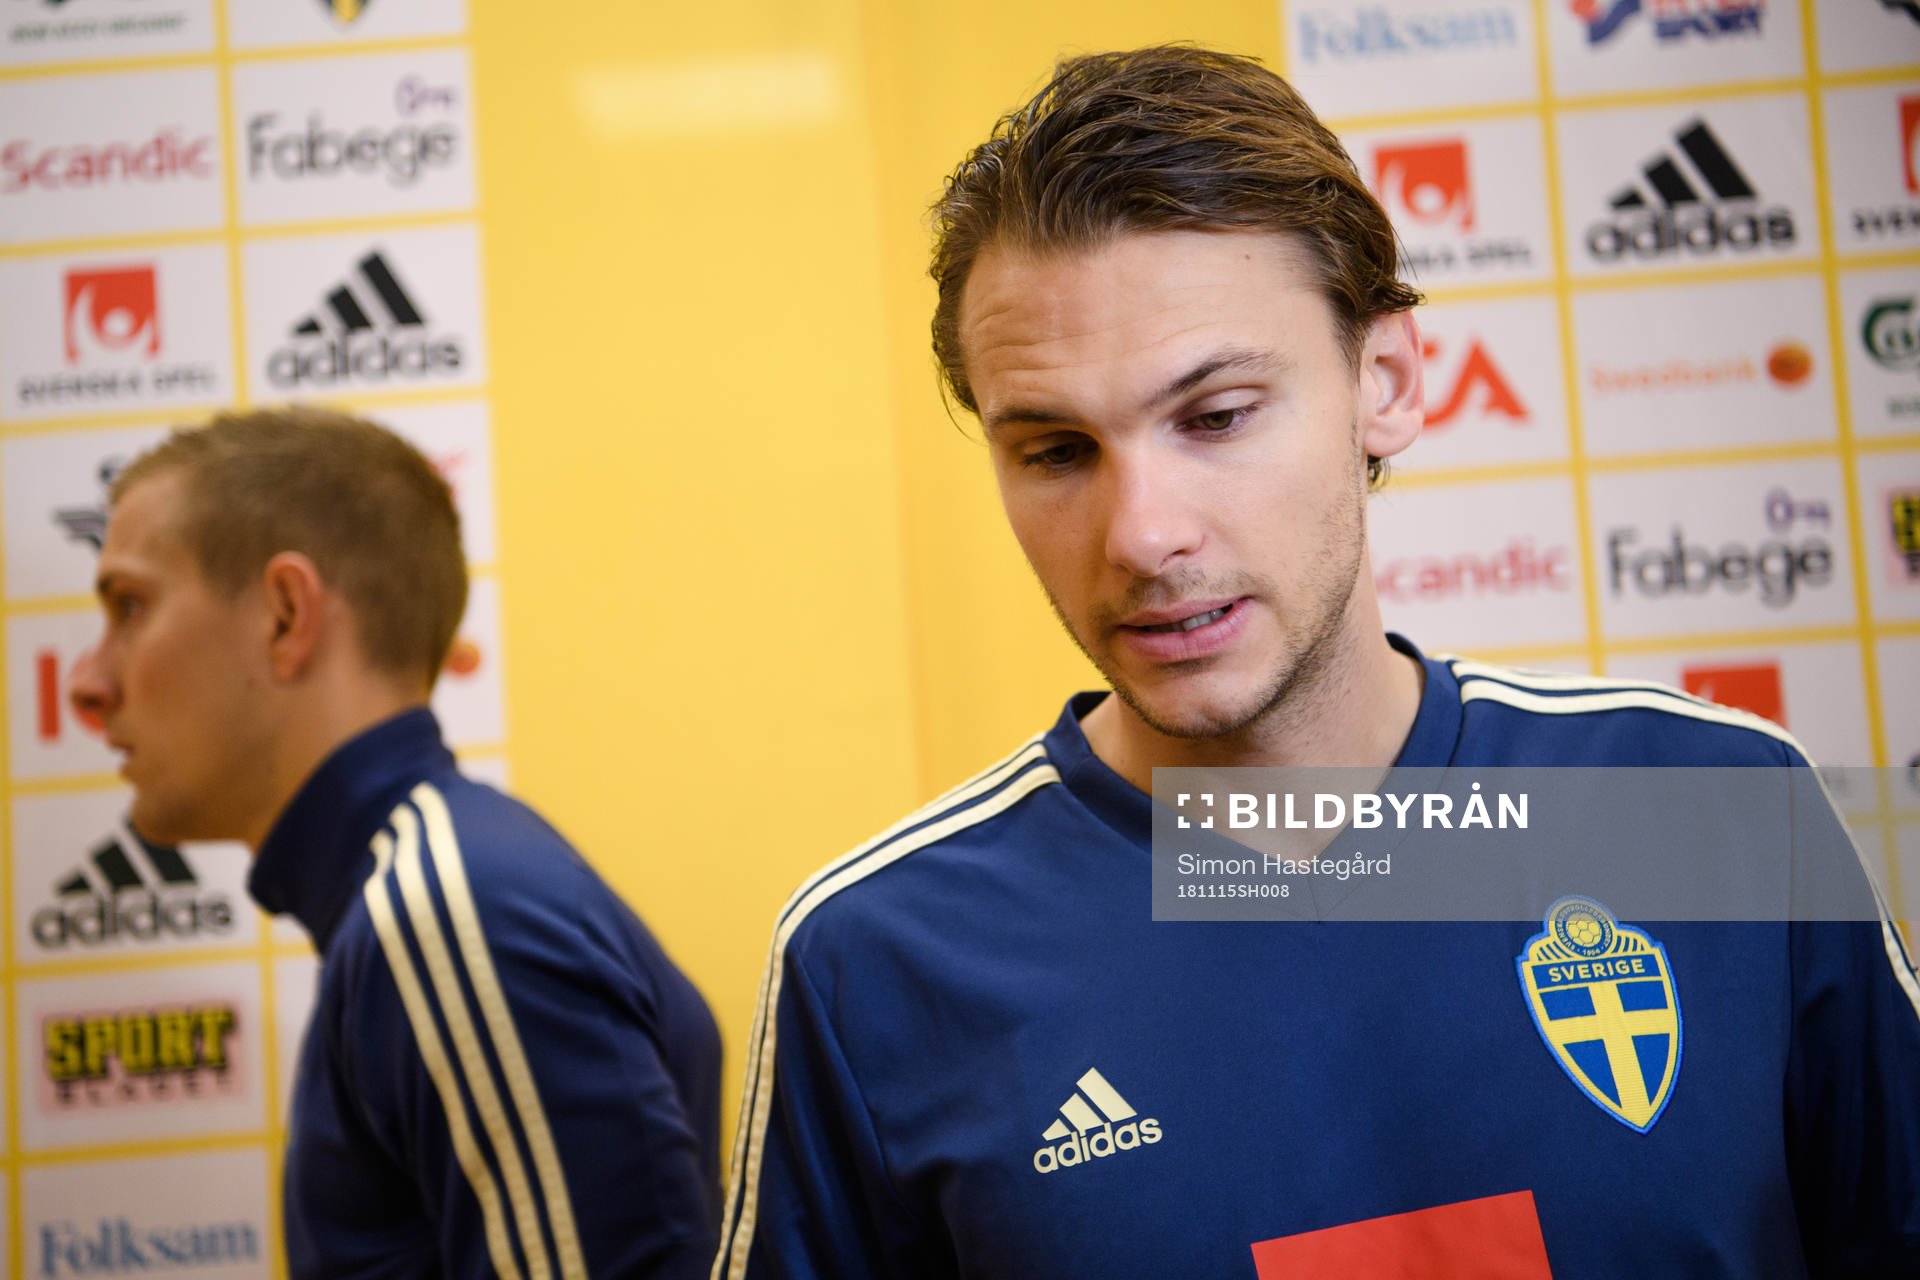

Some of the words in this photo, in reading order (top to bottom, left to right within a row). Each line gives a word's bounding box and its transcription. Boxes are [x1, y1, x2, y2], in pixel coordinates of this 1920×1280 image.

[0, 130, 212, 191] Scandic
[247, 111, 458, 186] Fabege
[1587, 204, 1796, 260] adidas
[267, 336, 463, 388] adidas
[1375, 537, 1570, 602] candic
[1608, 525, 1833, 607] Fabege
[32, 893, 233, 948] adidas
[1549, 958, 1645, 983] SVERIGE
[46, 1006, 234, 1080] SPORT
[1033, 1117, 1163, 1174] adidas
[38, 1217, 258, 1275] Folksam
